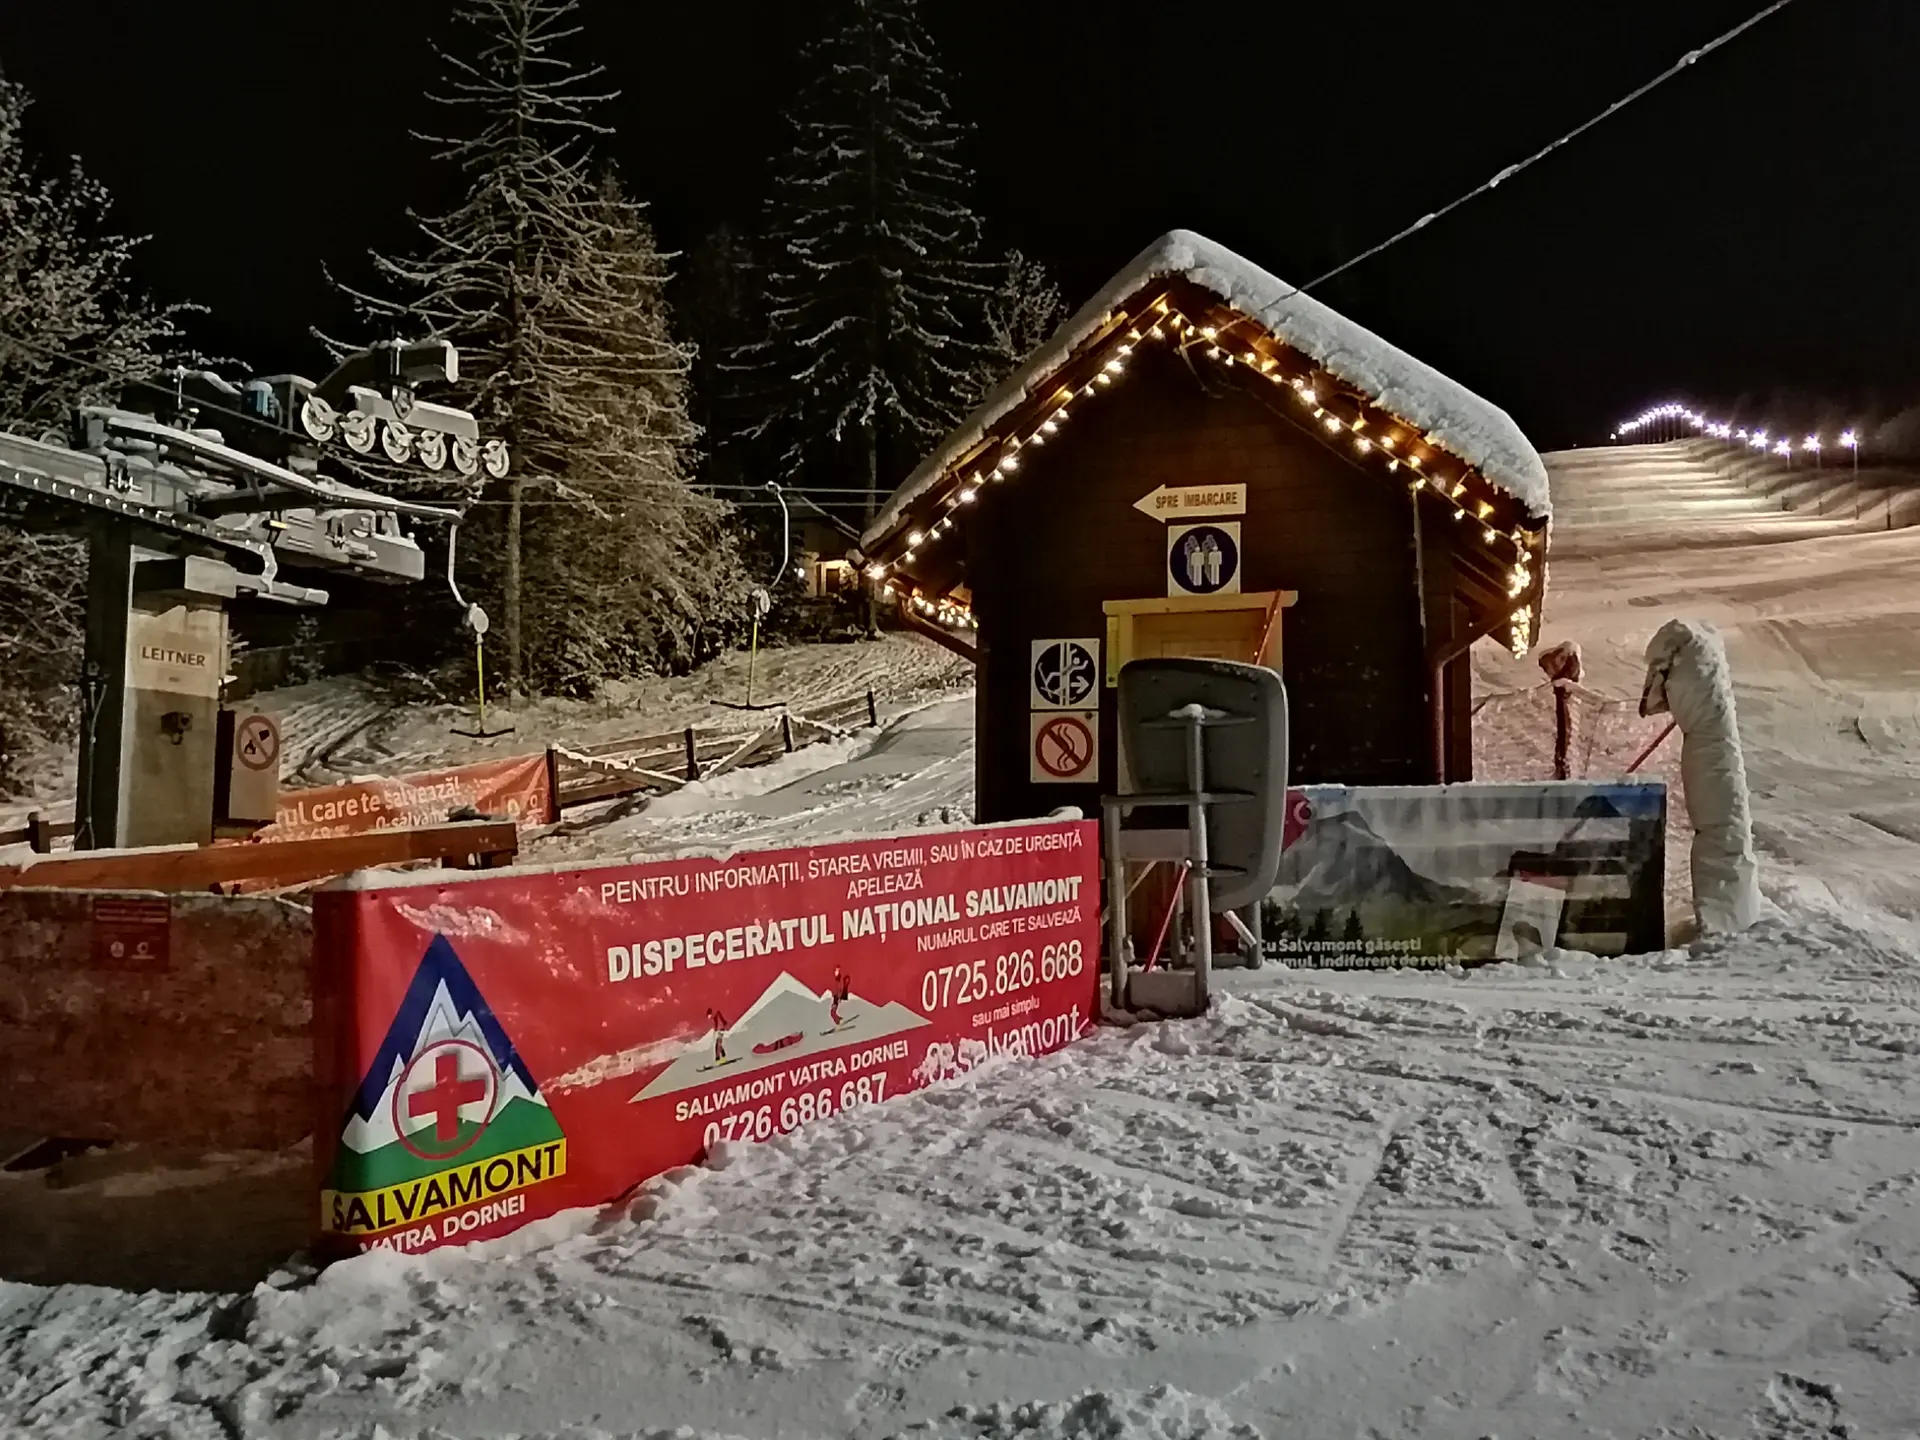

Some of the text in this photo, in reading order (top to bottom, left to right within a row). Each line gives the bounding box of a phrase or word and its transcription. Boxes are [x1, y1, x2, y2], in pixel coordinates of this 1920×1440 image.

[1155, 495, 1179, 509] SPRE
[142, 646, 206, 667] LEITNER
[312, 798, 358, 822] care
[360, 792, 381, 814] te
[601, 829, 1083, 905] PENTRU INFORMAȚII, STAREA VREMII, SAU ÎN CAZ DE URGENȚĂ
[847, 869, 924, 900] APELEAZĂ
[606, 875, 1083, 983] DISPECERATUL NAȚIONAL SALVAMONT
[917, 905, 1082, 953] NUMĂRUL CARE TE SALVEAZĂ
[1279, 937, 1363, 952] Salvamont
[921, 939, 1083, 1012] 0725.826.668
[1320, 953, 1397, 967] indiferent
[1399, 952, 1419, 967] de
[972, 995, 1040, 1027] sau mai simplu
[675, 1039, 909, 1122] SALVAMONT VATRA DORNEI
[703, 1071, 888, 1150] 0726.686.687
[331, 1143, 561, 1232] SALVAMONT
[443, 1194, 526, 1239] DORNEI
